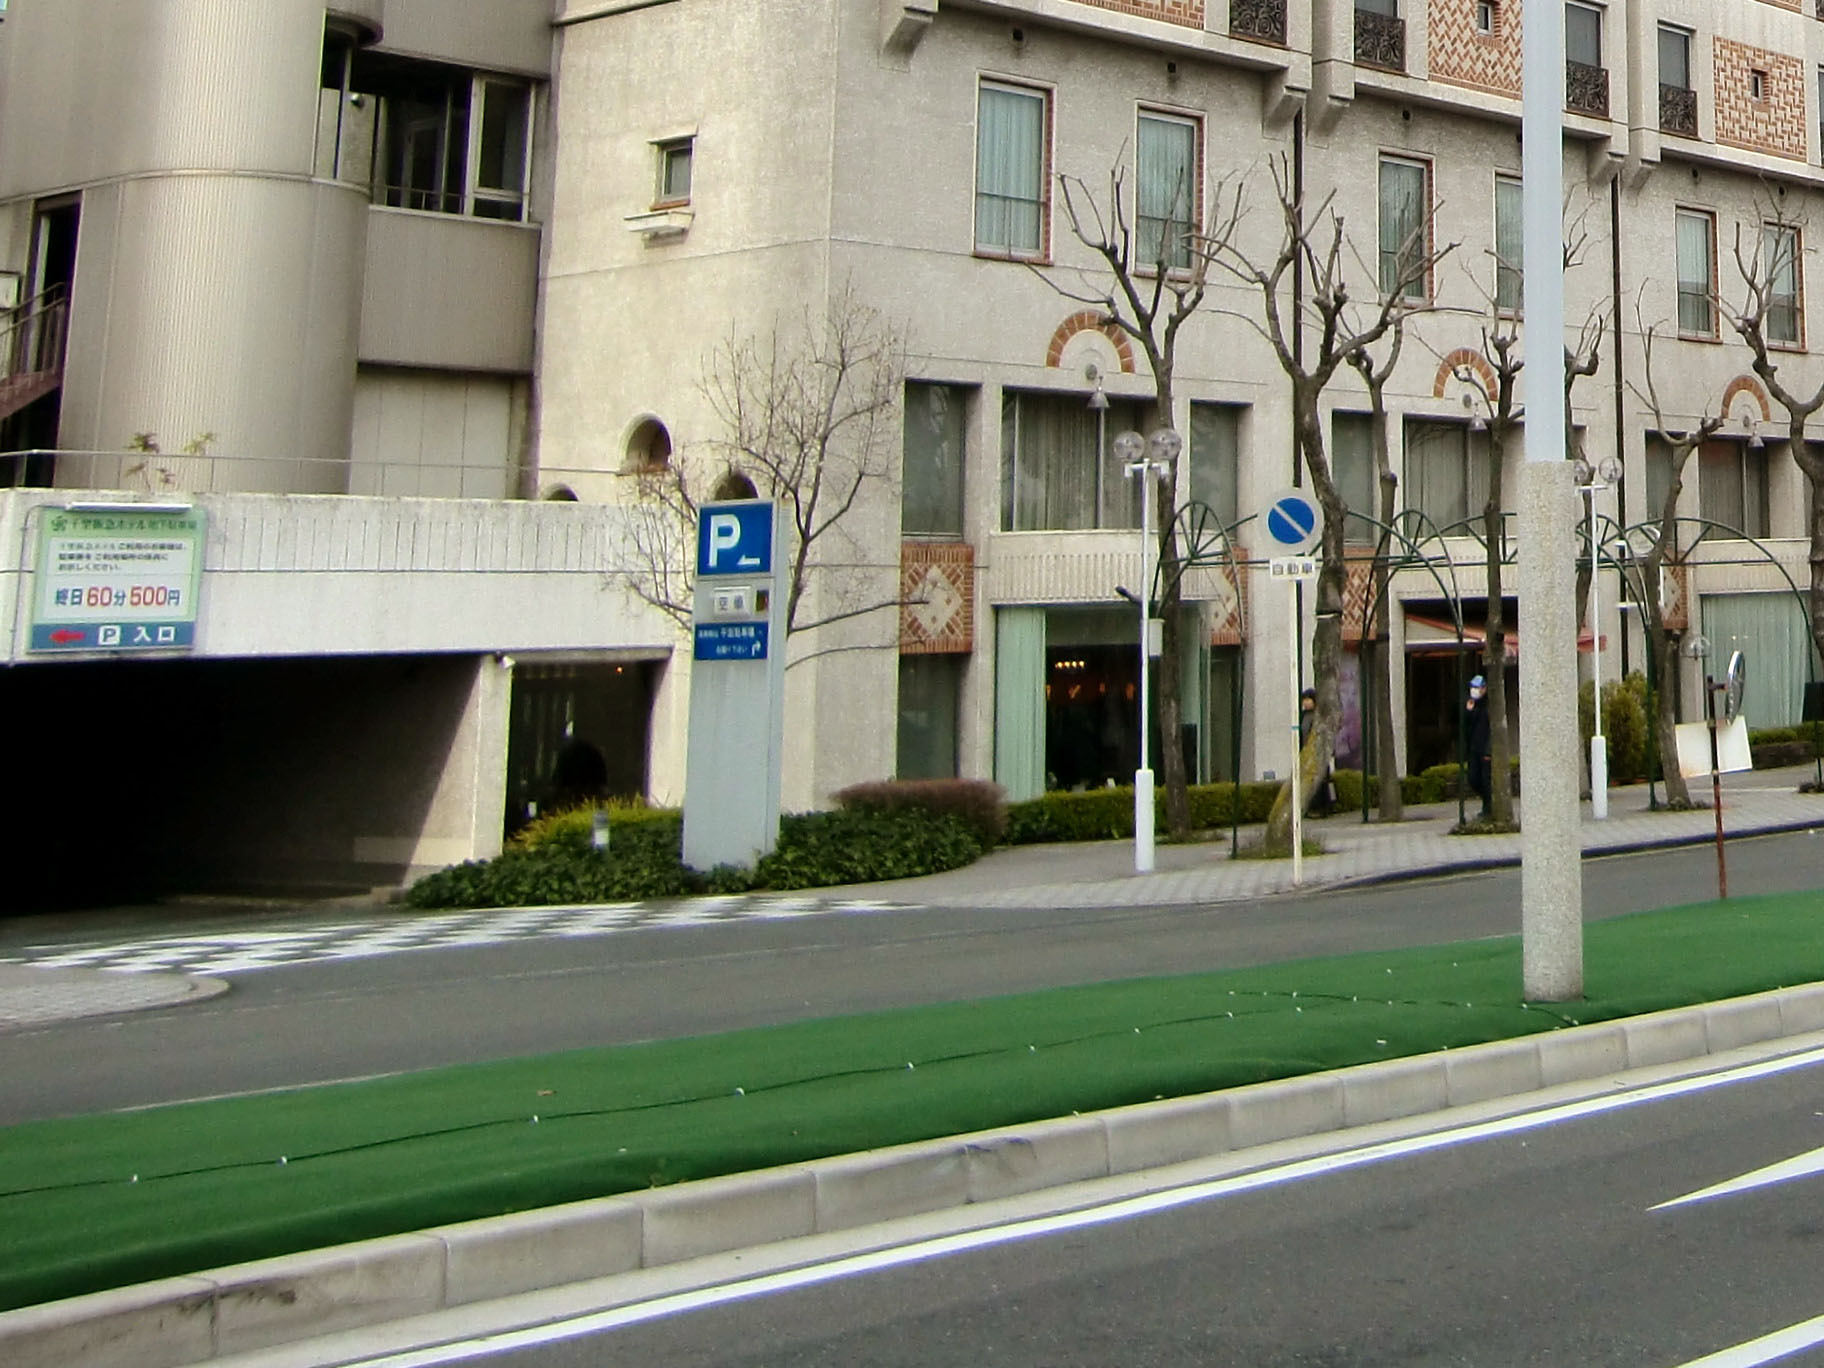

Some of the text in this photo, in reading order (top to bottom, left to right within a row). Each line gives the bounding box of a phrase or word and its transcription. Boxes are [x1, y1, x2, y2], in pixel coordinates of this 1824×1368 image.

[708, 513, 741, 568] P
[1272, 562, 1313, 575] 自動車
[134, 626, 176, 644] 入口
